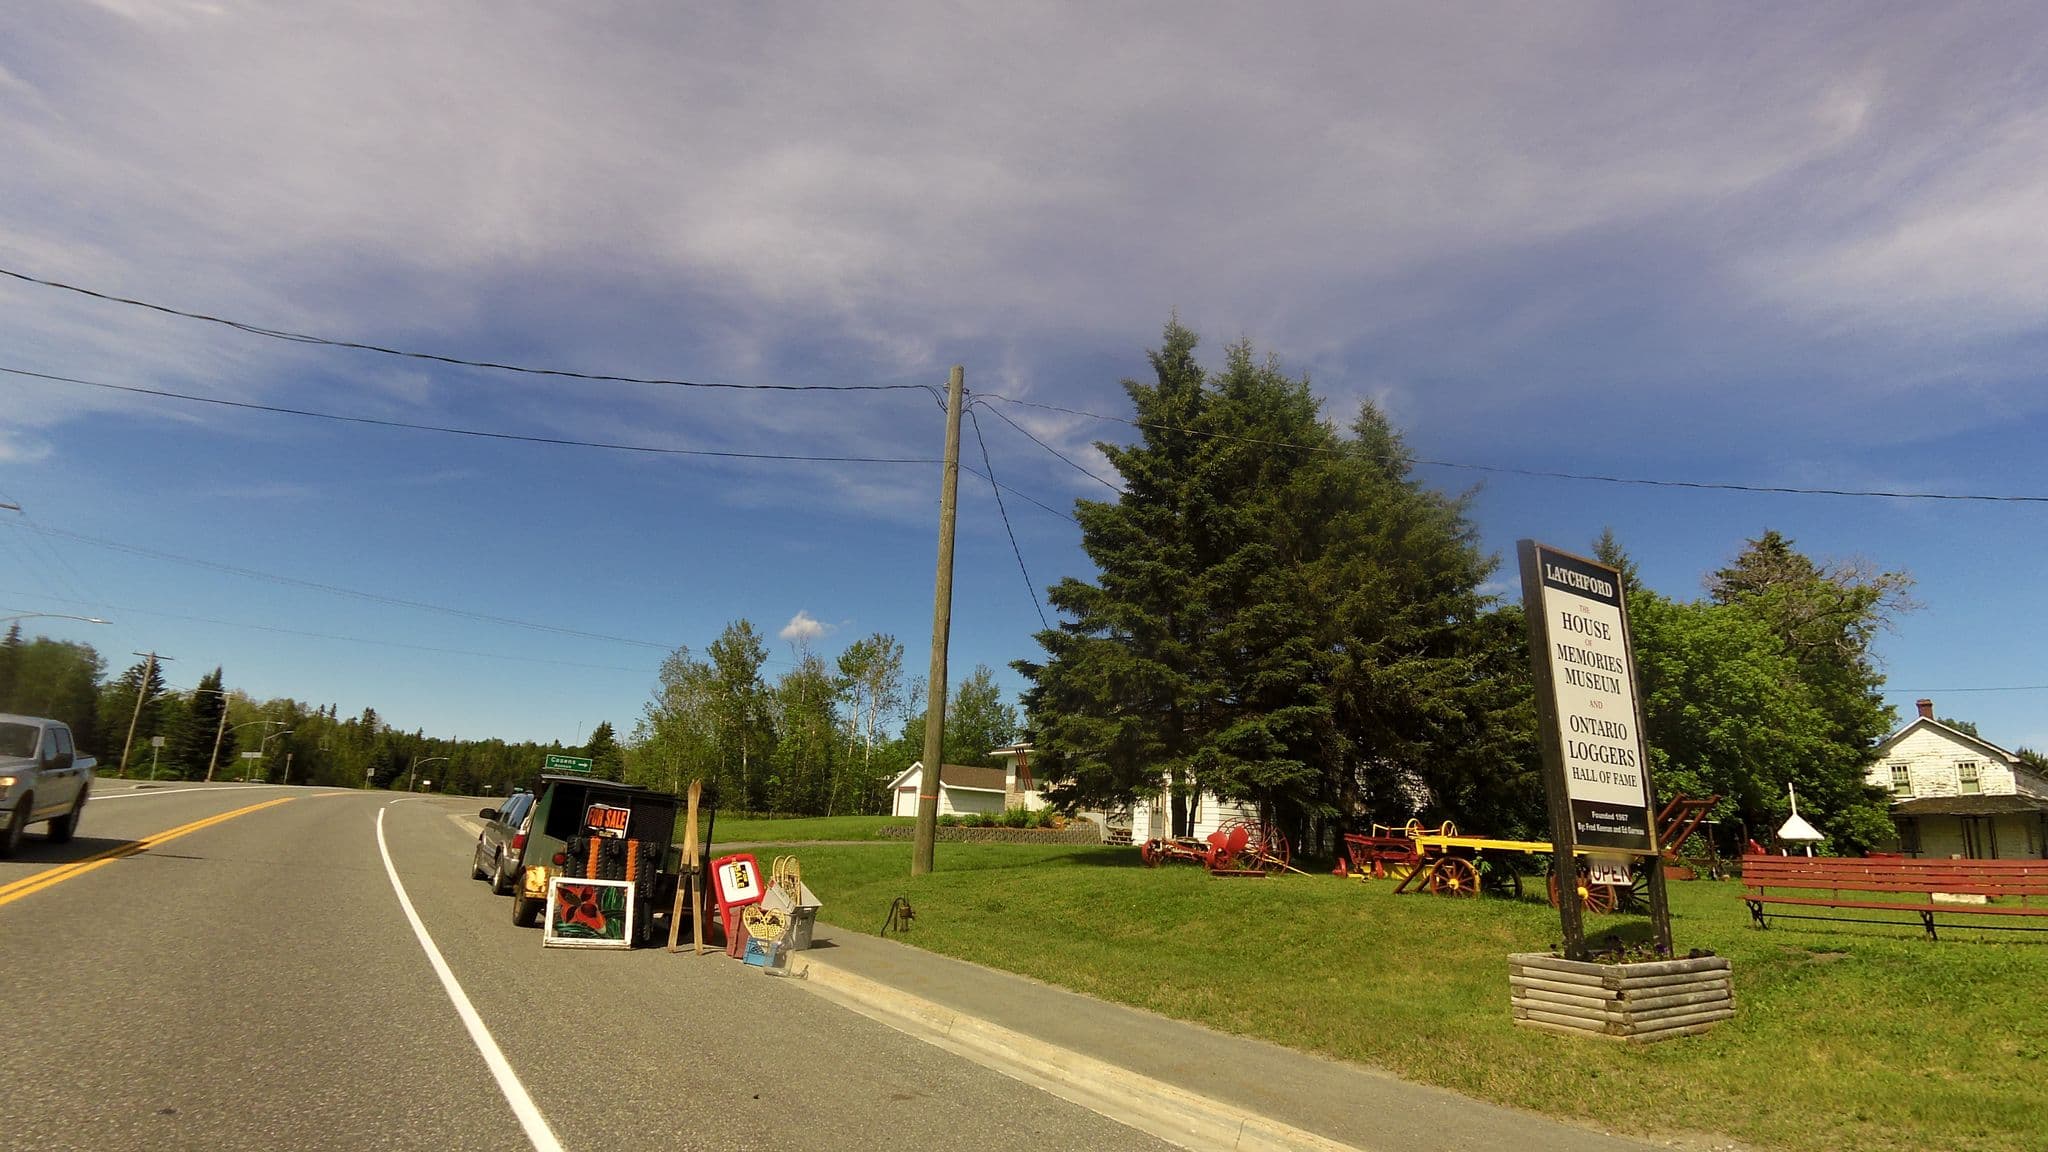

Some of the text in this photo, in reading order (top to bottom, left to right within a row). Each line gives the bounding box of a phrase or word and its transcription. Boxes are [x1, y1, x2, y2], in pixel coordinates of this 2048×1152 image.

[1545, 563, 1613, 598] LATCHFORD
[1579, 604, 1591, 614] THE
[1561, 611, 1611, 641] HOUSE
[1584, 639, 1592, 647] OF
[1557, 643, 1624, 674] MEMORIES
[1565, 667, 1621, 695] MUSEUM
[1588, 700, 1604, 710] AND
[1569, 714, 1628, 741] ONTARIO
[1568, 740, 1636, 768] LOGGERS
[1572, 766, 1637, 788] HALL OF FAME
[588, 808, 626, 829] FOR SALE
[1591, 810, 1615, 821] Founded
[1592, 863, 1632, 882] OPEN
